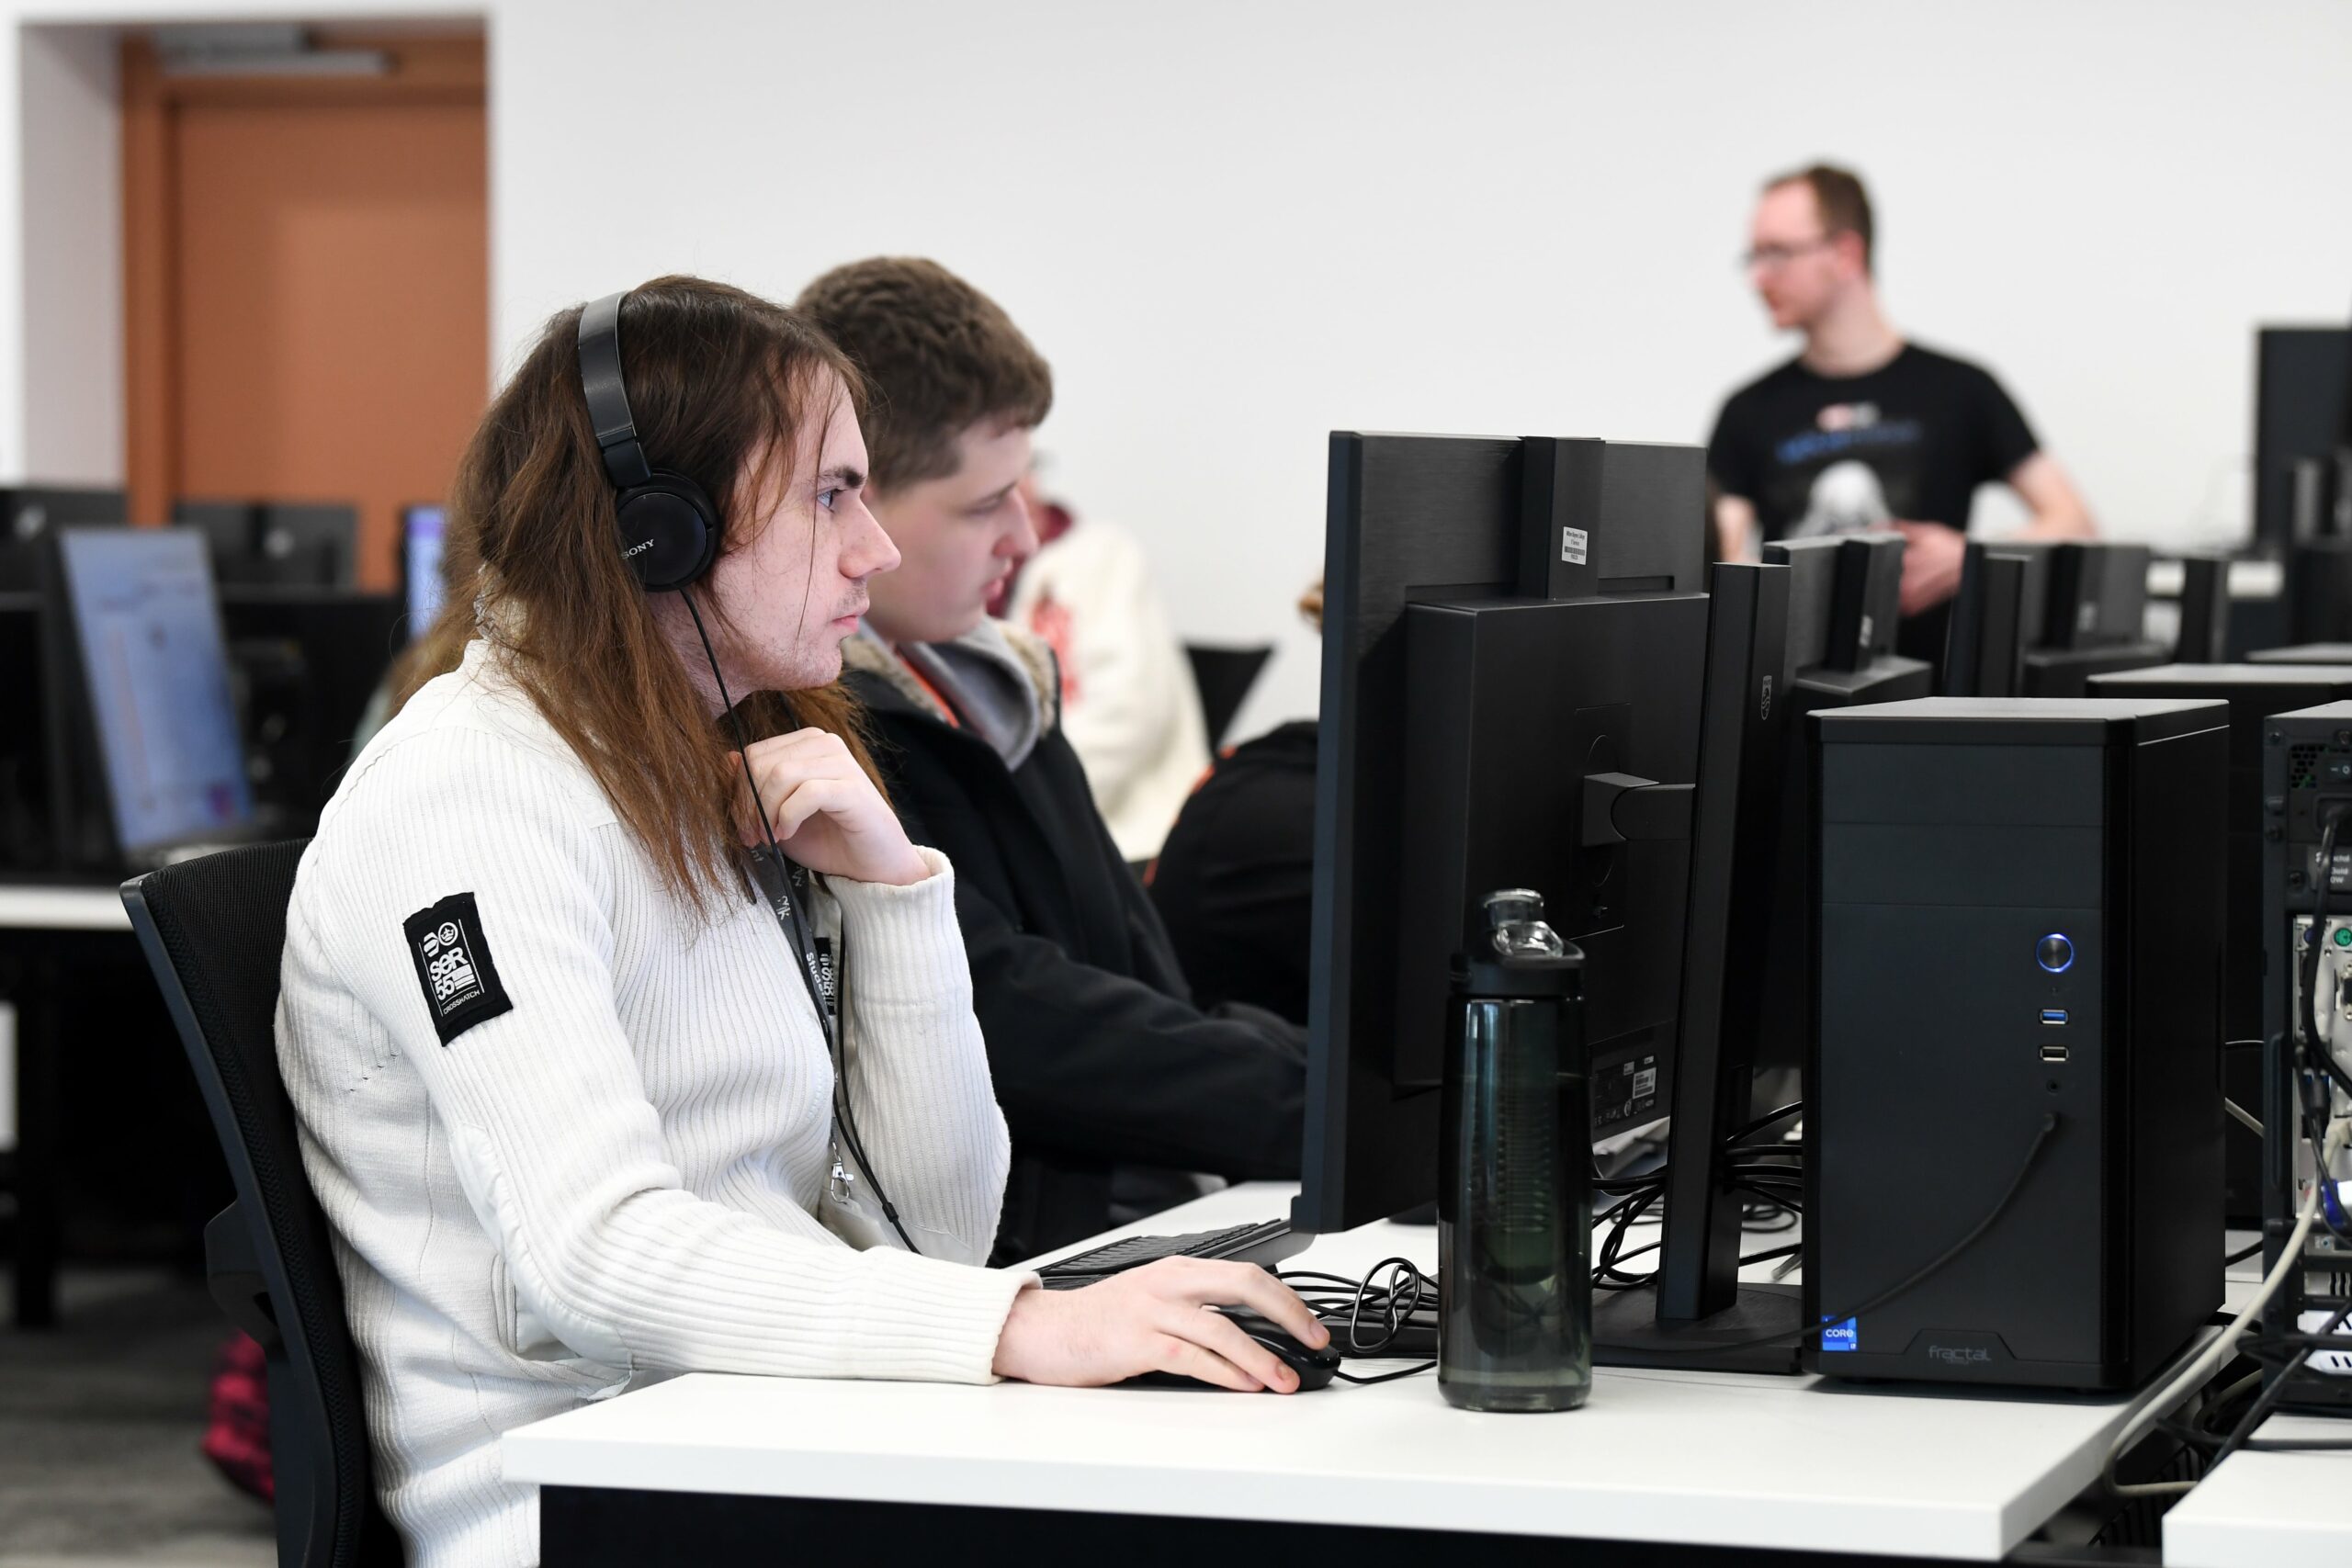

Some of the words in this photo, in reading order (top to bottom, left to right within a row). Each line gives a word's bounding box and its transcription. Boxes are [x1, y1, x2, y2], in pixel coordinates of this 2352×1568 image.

[621, 538, 655, 559] SONY
[434, 975, 456, 1000] 55
[443, 990, 481, 1015] CROSSHATCH
[1928, 1344, 1992, 1361] fractal
